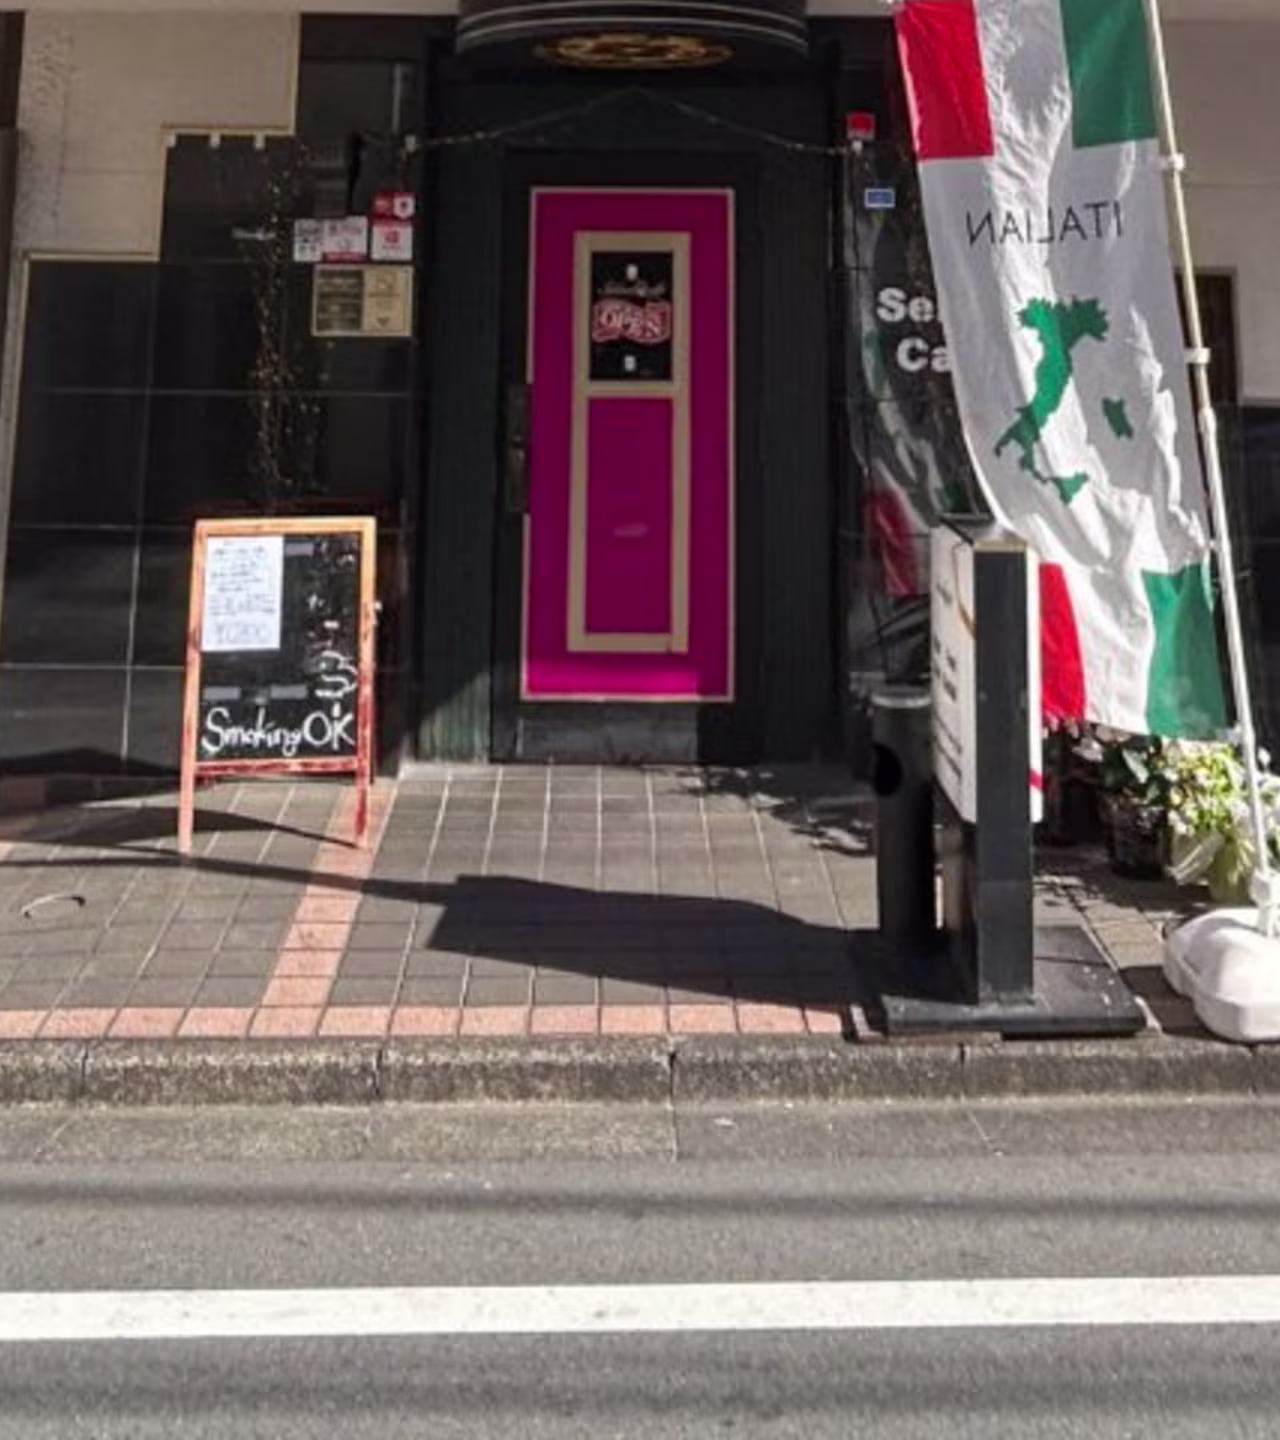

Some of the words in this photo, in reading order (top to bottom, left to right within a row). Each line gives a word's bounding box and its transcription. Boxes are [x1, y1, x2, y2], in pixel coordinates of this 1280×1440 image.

[876, 287, 937, 322] Se
[896, 337, 952, 372] Ca
[201, 706, 302, 756] Smoking
